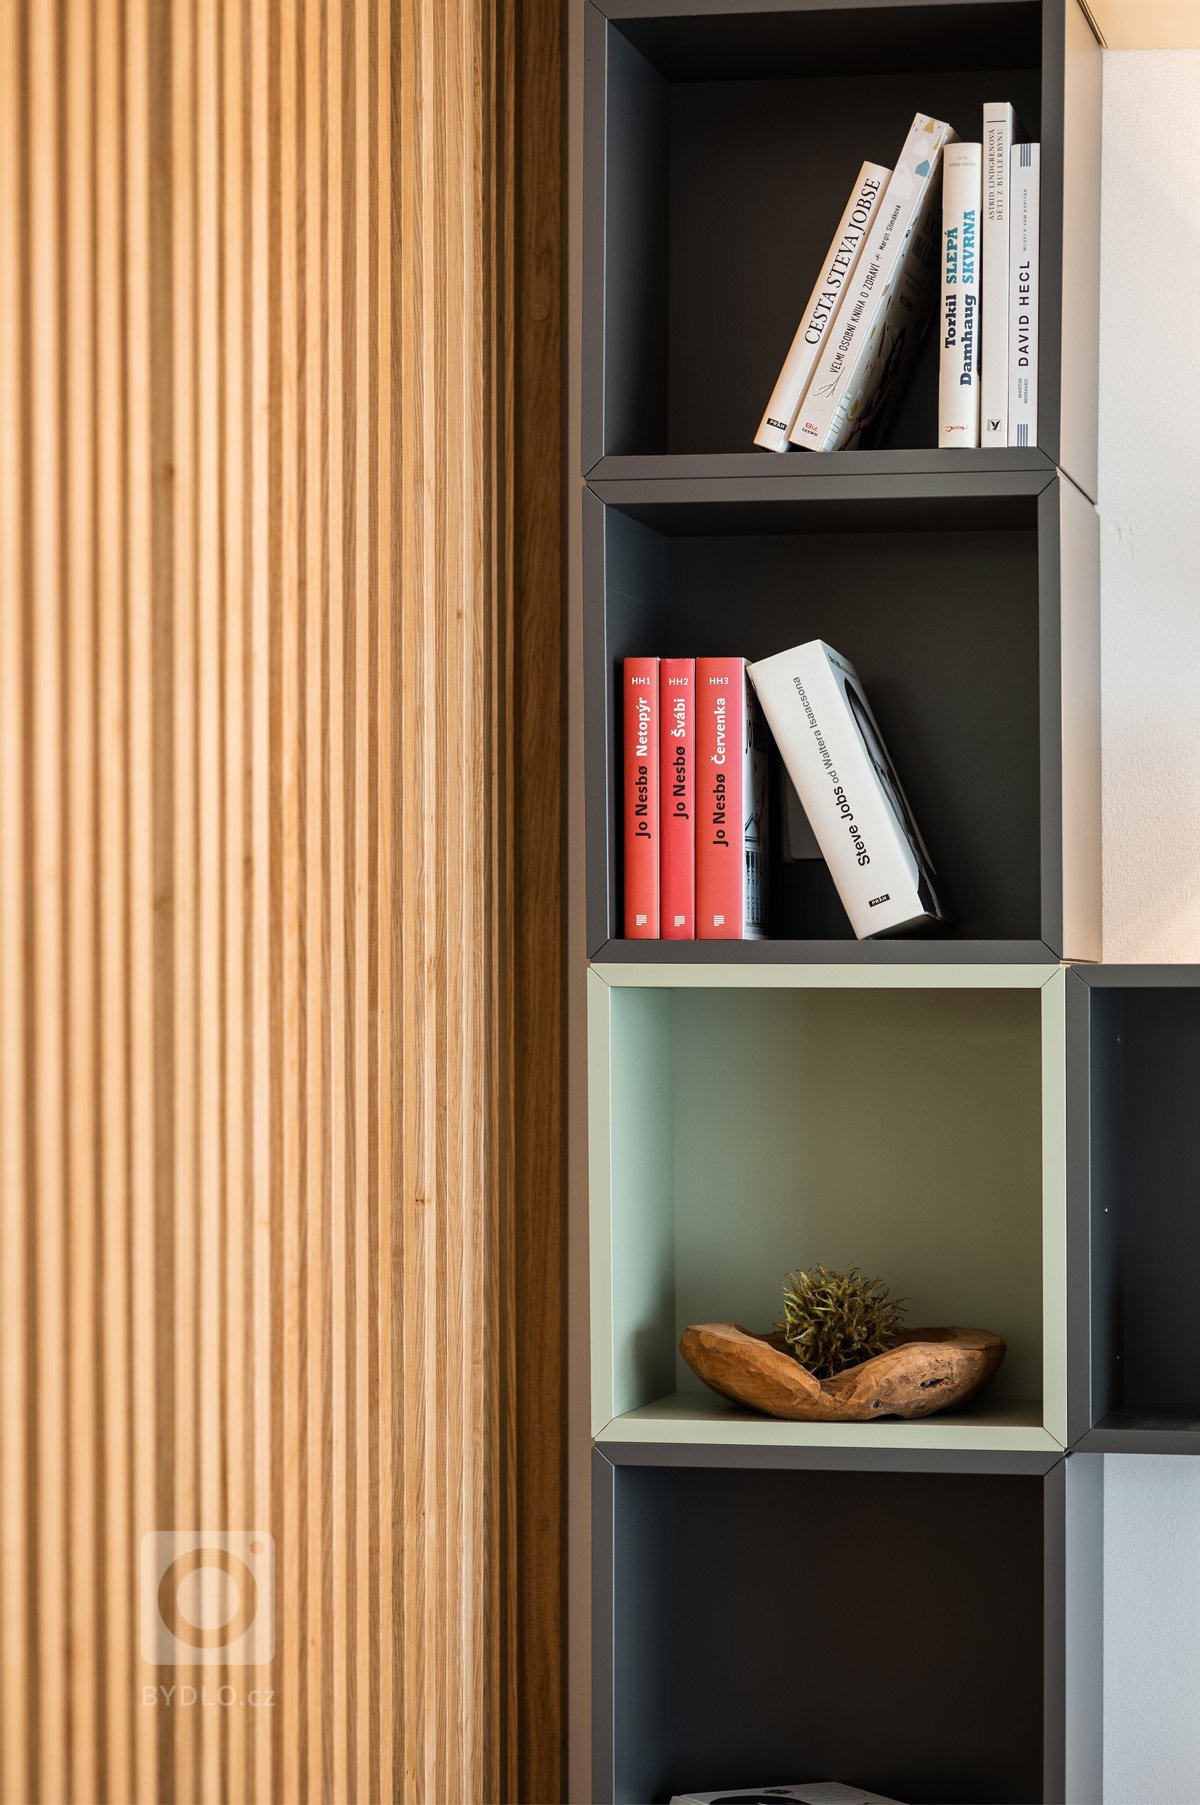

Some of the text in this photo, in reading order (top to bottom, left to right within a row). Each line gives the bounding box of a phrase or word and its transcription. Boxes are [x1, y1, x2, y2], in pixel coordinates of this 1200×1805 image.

[804, 178, 881, 345] CESTA STEVA JOBSE
[878, 232, 891, 251] Margit
[945, 227, 958, 284] SLEPÁ
[962, 209, 976, 284] SKVRNA
[830, 263, 881, 374] VELMI OSOBNÍ KNIHA O ZDRAVÍ
[945, 294, 977, 386] Torkil Damhaug
[1018, 260, 1030, 367] DAVID HECL
[631, 677, 651, 685] HH1
[668, 678, 689, 686] HH2
[709, 677, 729, 685] HH3
[635, 697, 651, 839] Jo Nesbø Netopýr
[670, 698, 689, 820] Jo Nesbø Švábi
[710, 697, 729, 847] Jo Nesbø Červenka
[793, 676, 871, 867] Steve Jobs od Waltera Isaacsona
